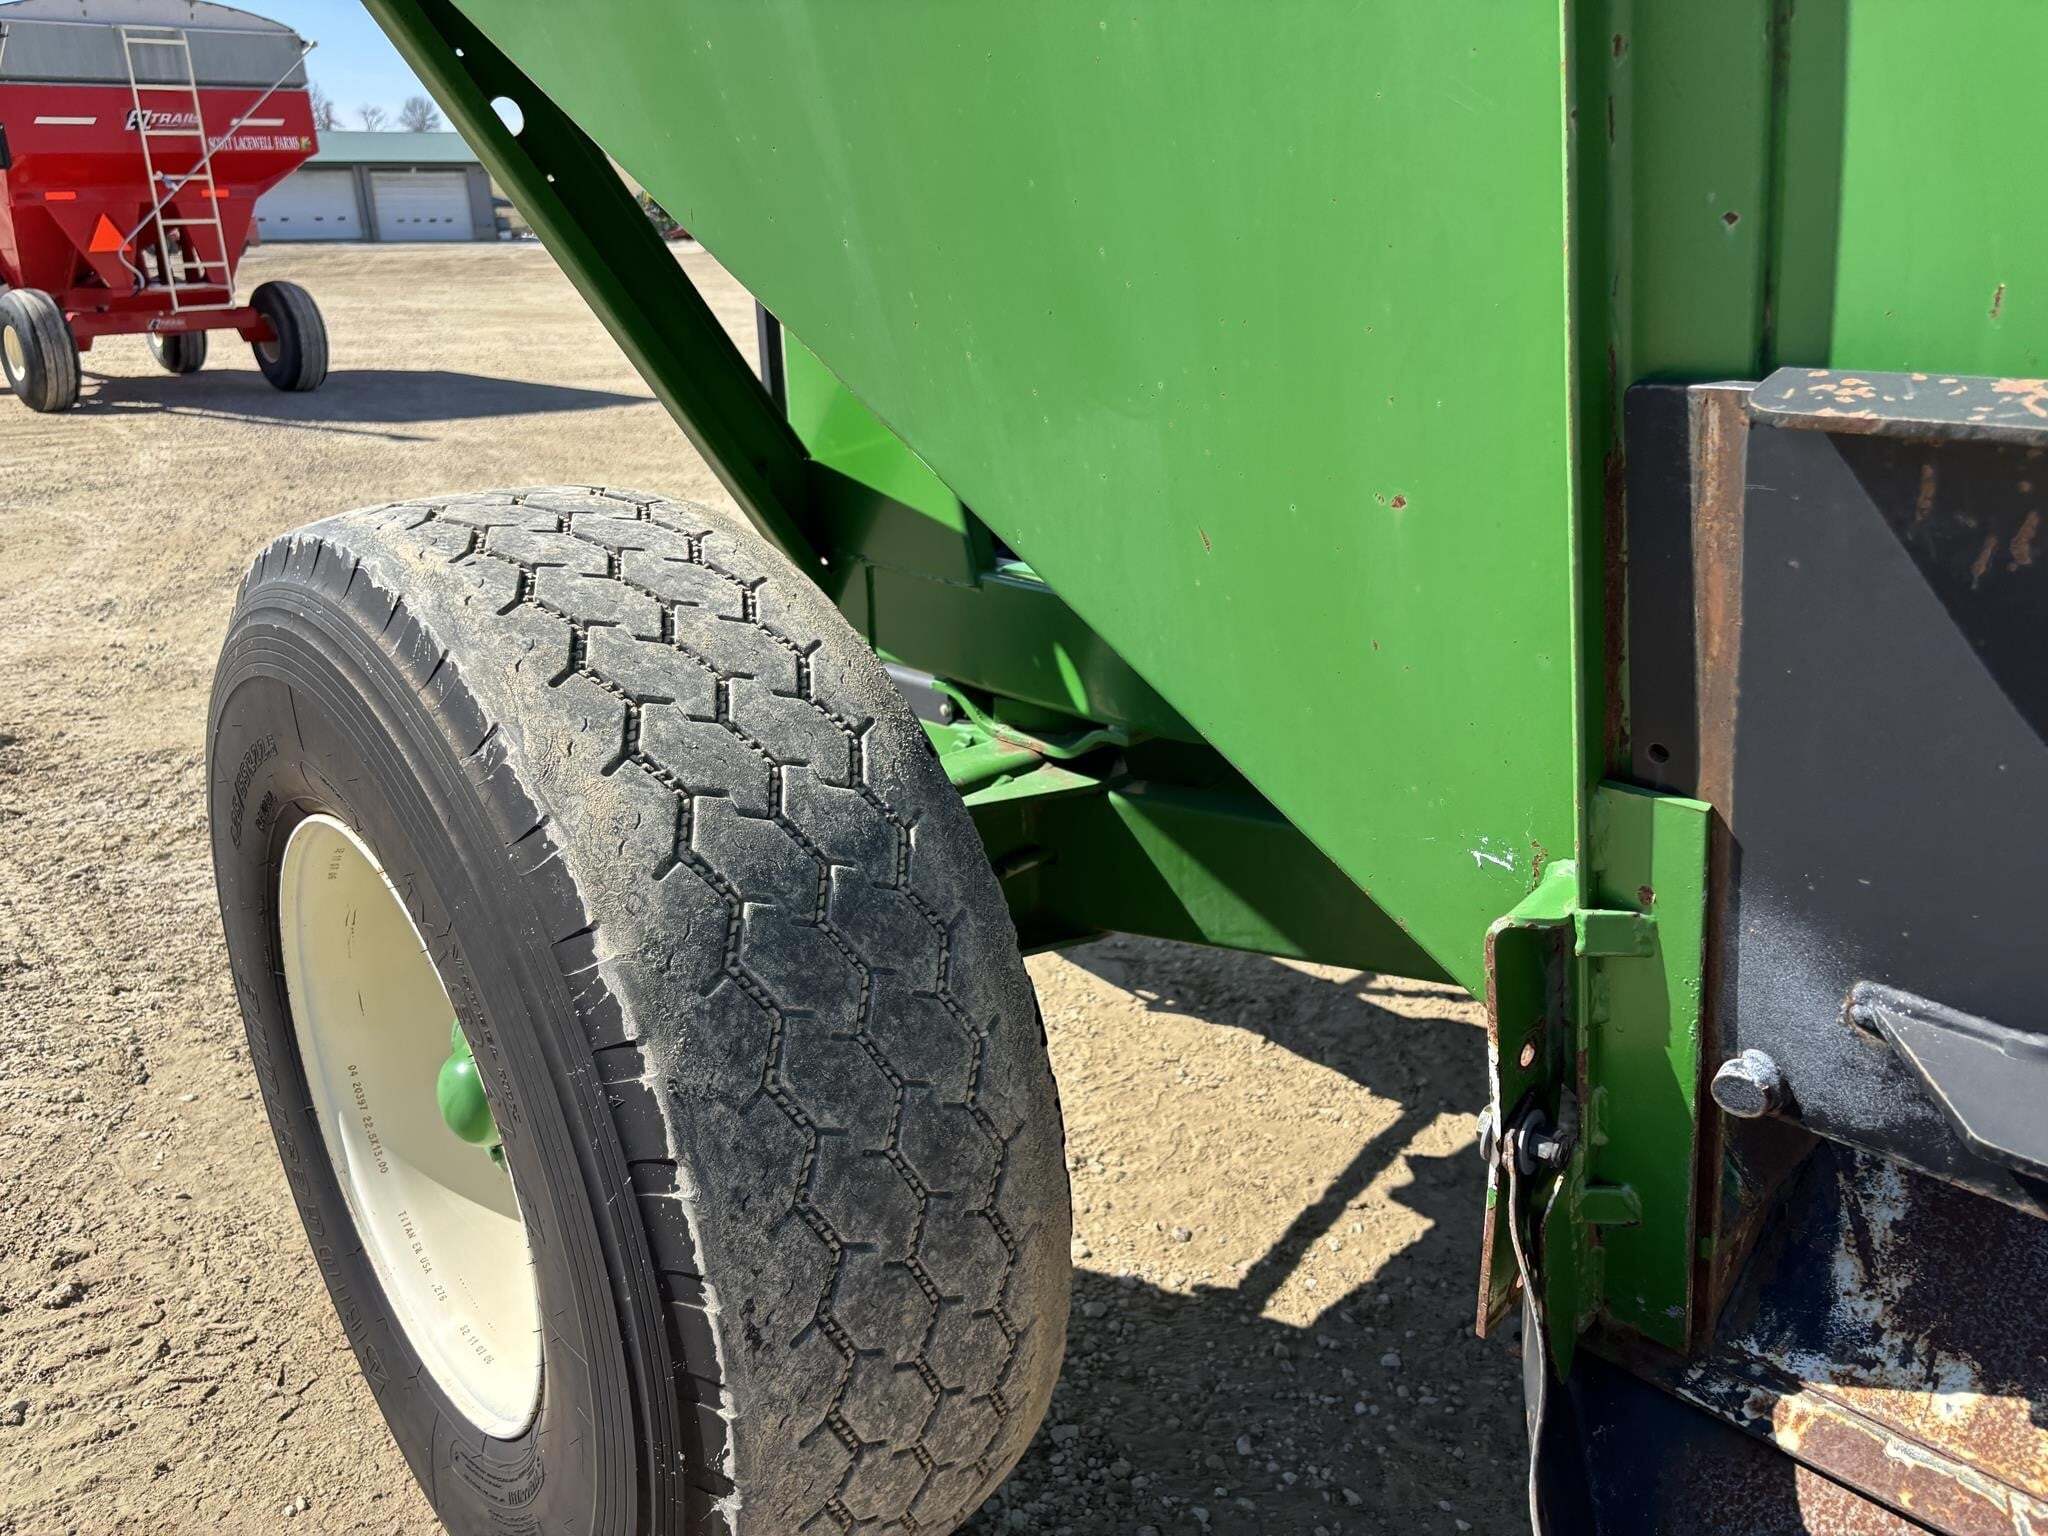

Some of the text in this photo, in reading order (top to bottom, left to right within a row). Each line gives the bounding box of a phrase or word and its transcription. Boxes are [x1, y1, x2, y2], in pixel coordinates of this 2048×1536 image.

[274, 136, 300, 150] FARMS
[347, 1064, 359, 1077] 04
[352, 1081, 369, 1110] 20397
[398, 1210, 417, 1240] TITAN
[419, 1256, 433, 1274] USA
